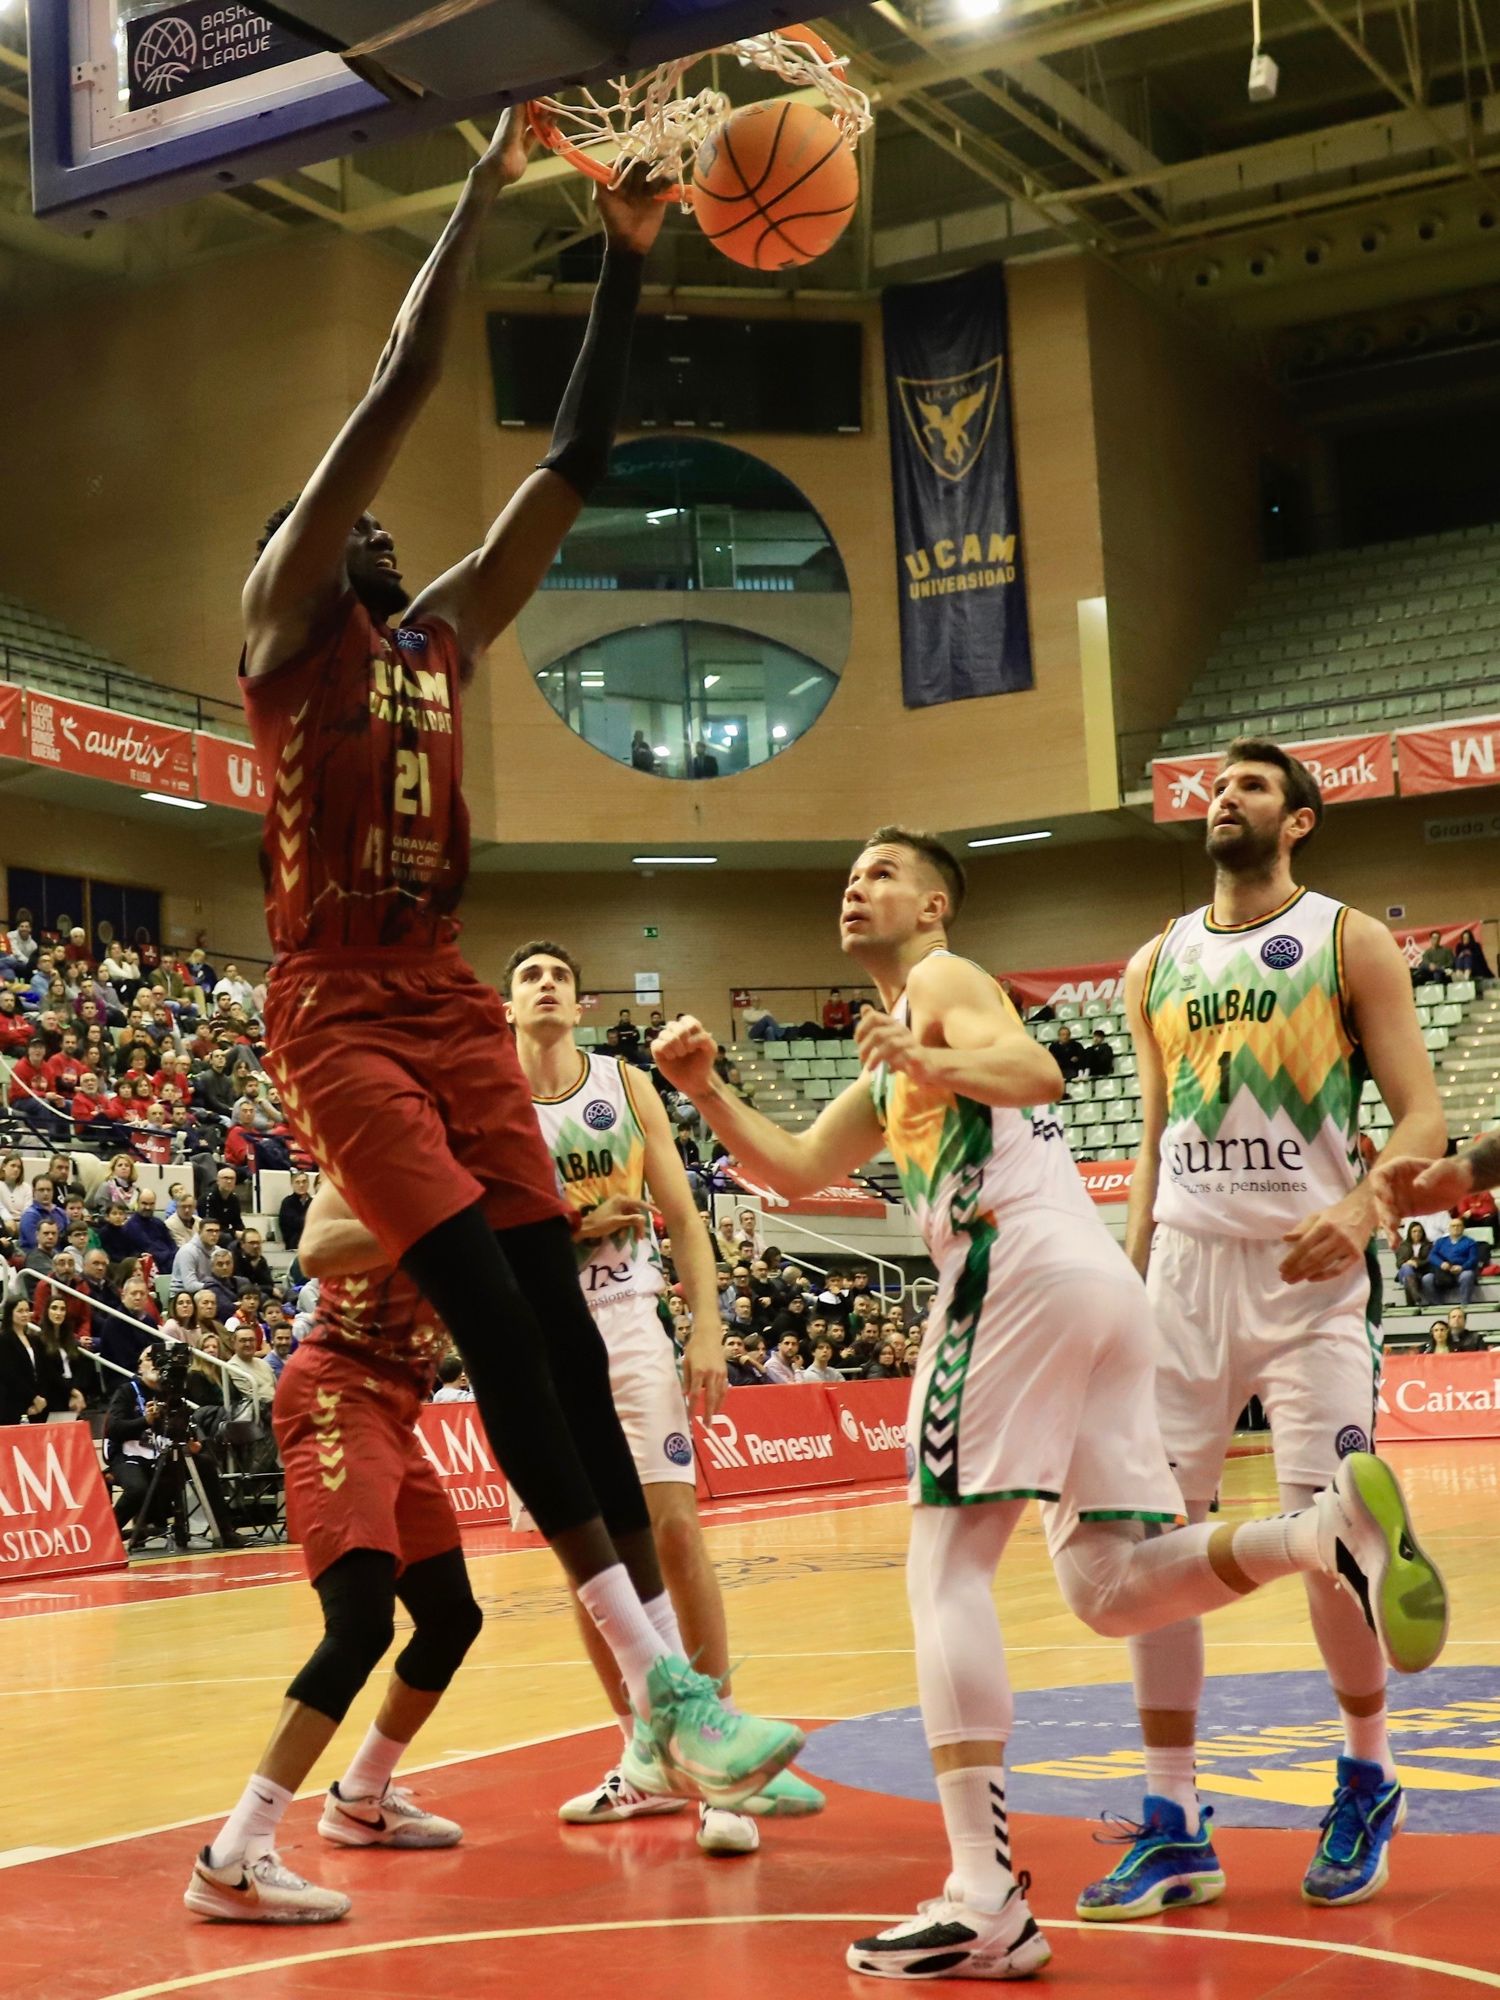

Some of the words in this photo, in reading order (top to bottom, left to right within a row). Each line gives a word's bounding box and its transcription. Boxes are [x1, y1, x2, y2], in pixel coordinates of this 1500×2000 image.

[201, 5, 254, 31] BASK
[202, 35, 271, 70] LEAGUE
[905, 533, 1016, 581] UCAM
[909, 566, 1016, 600] UNIVERSIDAD
[373, 659, 450, 709] UM
[395, 749, 432, 818] 21
[401, 853, 415, 865] LA
[1186, 988, 1278, 1033] BILBAO
[1217, 1050, 1233, 1105] 1
[556, 1148, 615, 1183] LBAO
[1230, 1179, 1309, 1195] pensiones
[412, 1417, 496, 1477] AM
[744, 1433, 834, 1465] Renesur
[443, 1484, 506, 1512] IDAD
[0, 1523, 92, 1563] SIDAD
